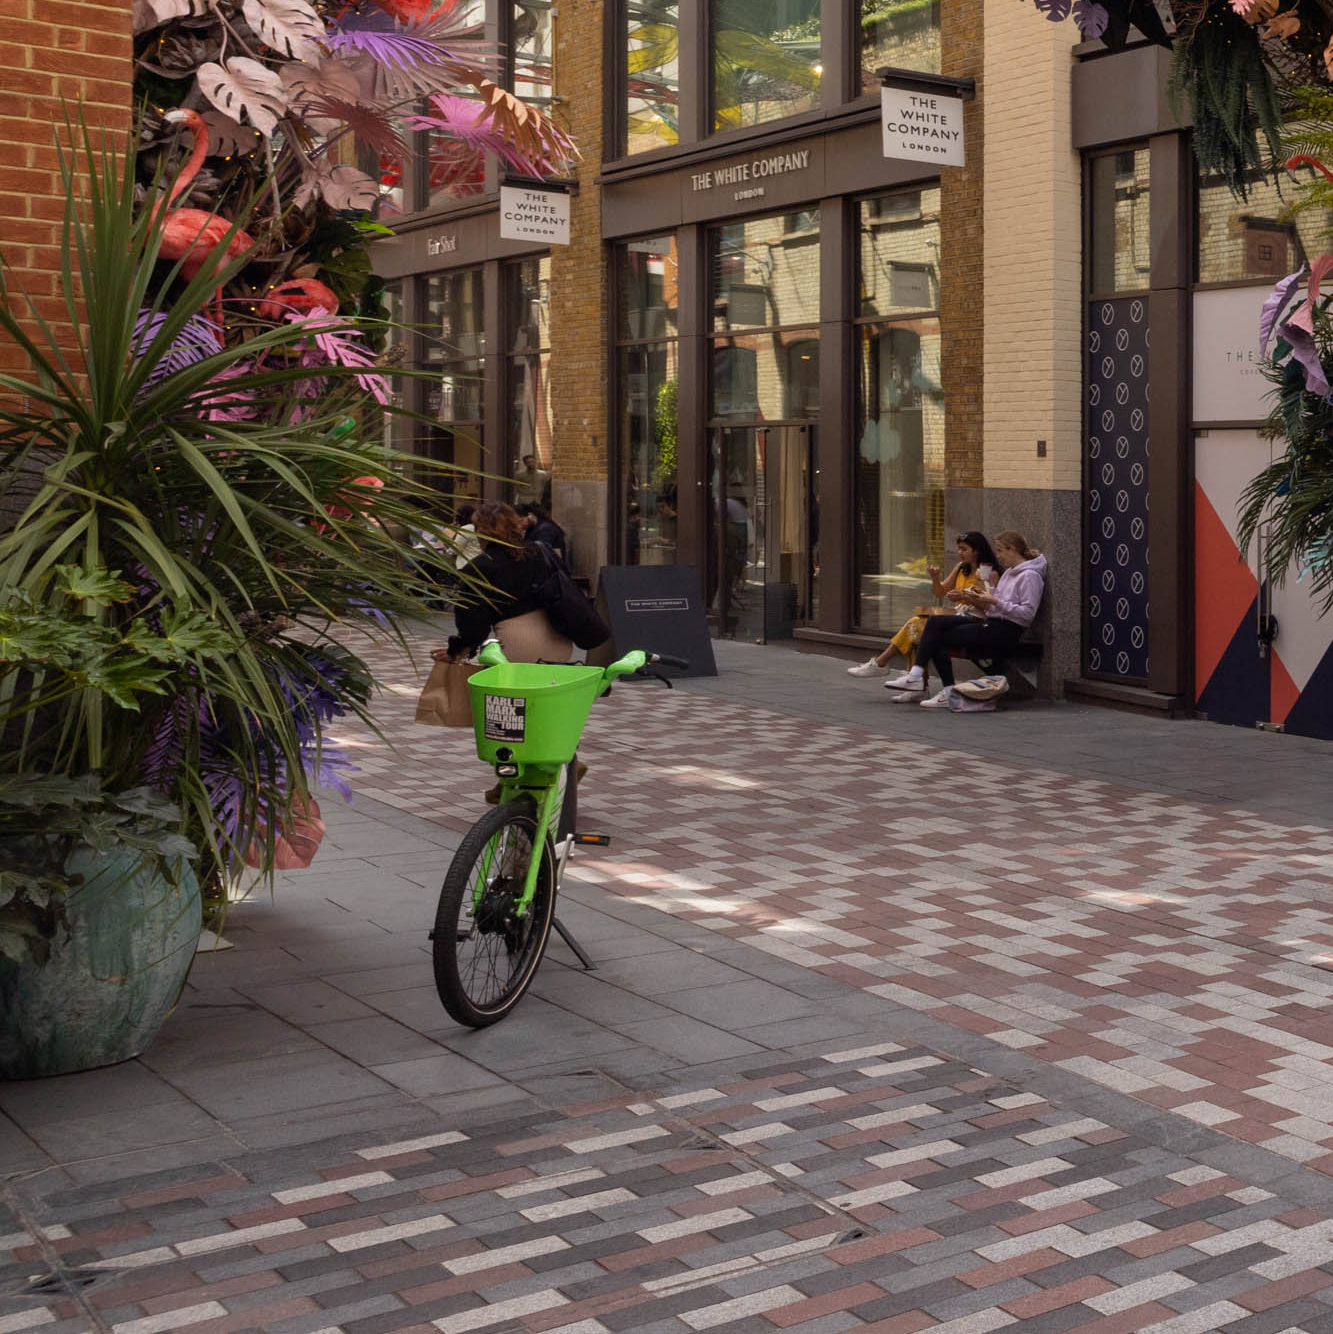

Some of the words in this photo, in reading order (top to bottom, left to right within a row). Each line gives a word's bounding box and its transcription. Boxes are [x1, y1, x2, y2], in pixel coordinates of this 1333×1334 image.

[910, 96, 937, 109] THE
[900, 109, 947, 125] WHITE
[887, 122, 960, 140] COMPANY
[902, 142, 947, 153] LONDON
[691, 172, 712, 191] THE
[714, 164, 750, 186] WHITE
[752, 150, 809, 178] COMPANY
[524, 193, 549, 203] THE
[734, 187, 765, 201] LONDON
[516, 203, 557, 214] WHITE
[504, 212, 567, 226] COMPANY
[516, 227, 555, 235] LONDON
[1226, 350, 1253, 363] THE
[486, 695, 513, 707] KARL
[486, 704, 517, 716] MARX
[486, 713, 524, 723] WALKING
[501, 722, 524, 731] TOUR
